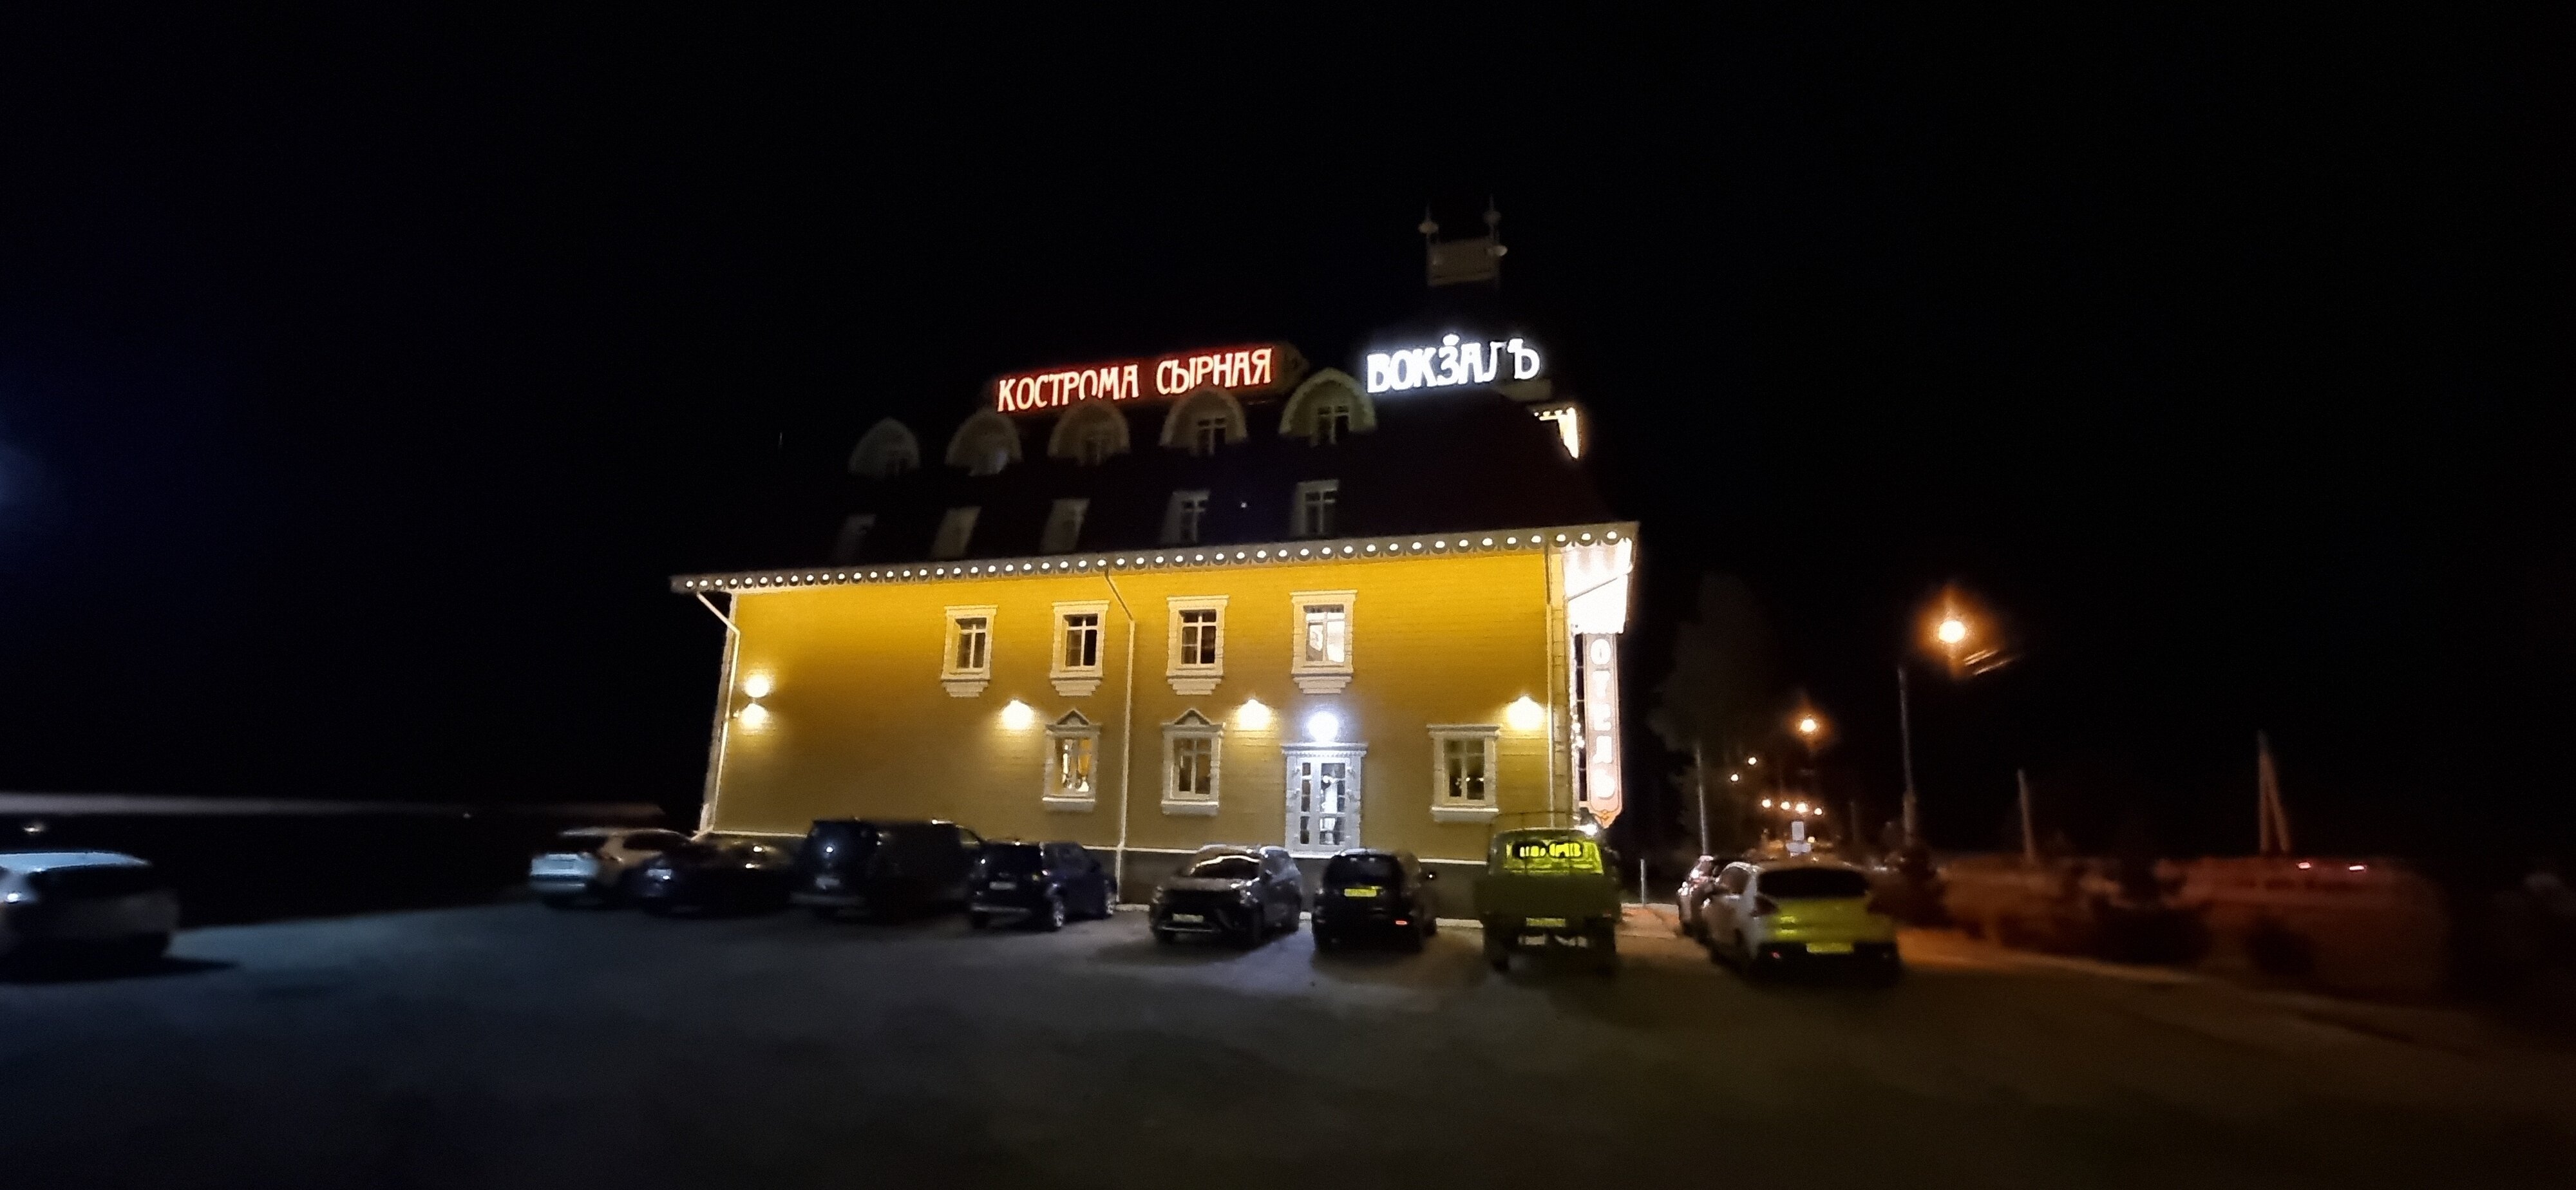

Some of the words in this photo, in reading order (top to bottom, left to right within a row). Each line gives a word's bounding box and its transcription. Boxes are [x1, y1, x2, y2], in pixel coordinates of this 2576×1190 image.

[997, 364, 1139, 412] КОСТРОМА
[1156, 348, 1273, 395] СЫРНАЯ
[1367, 333, 1540, 393] ВОКЗАЛЪ
